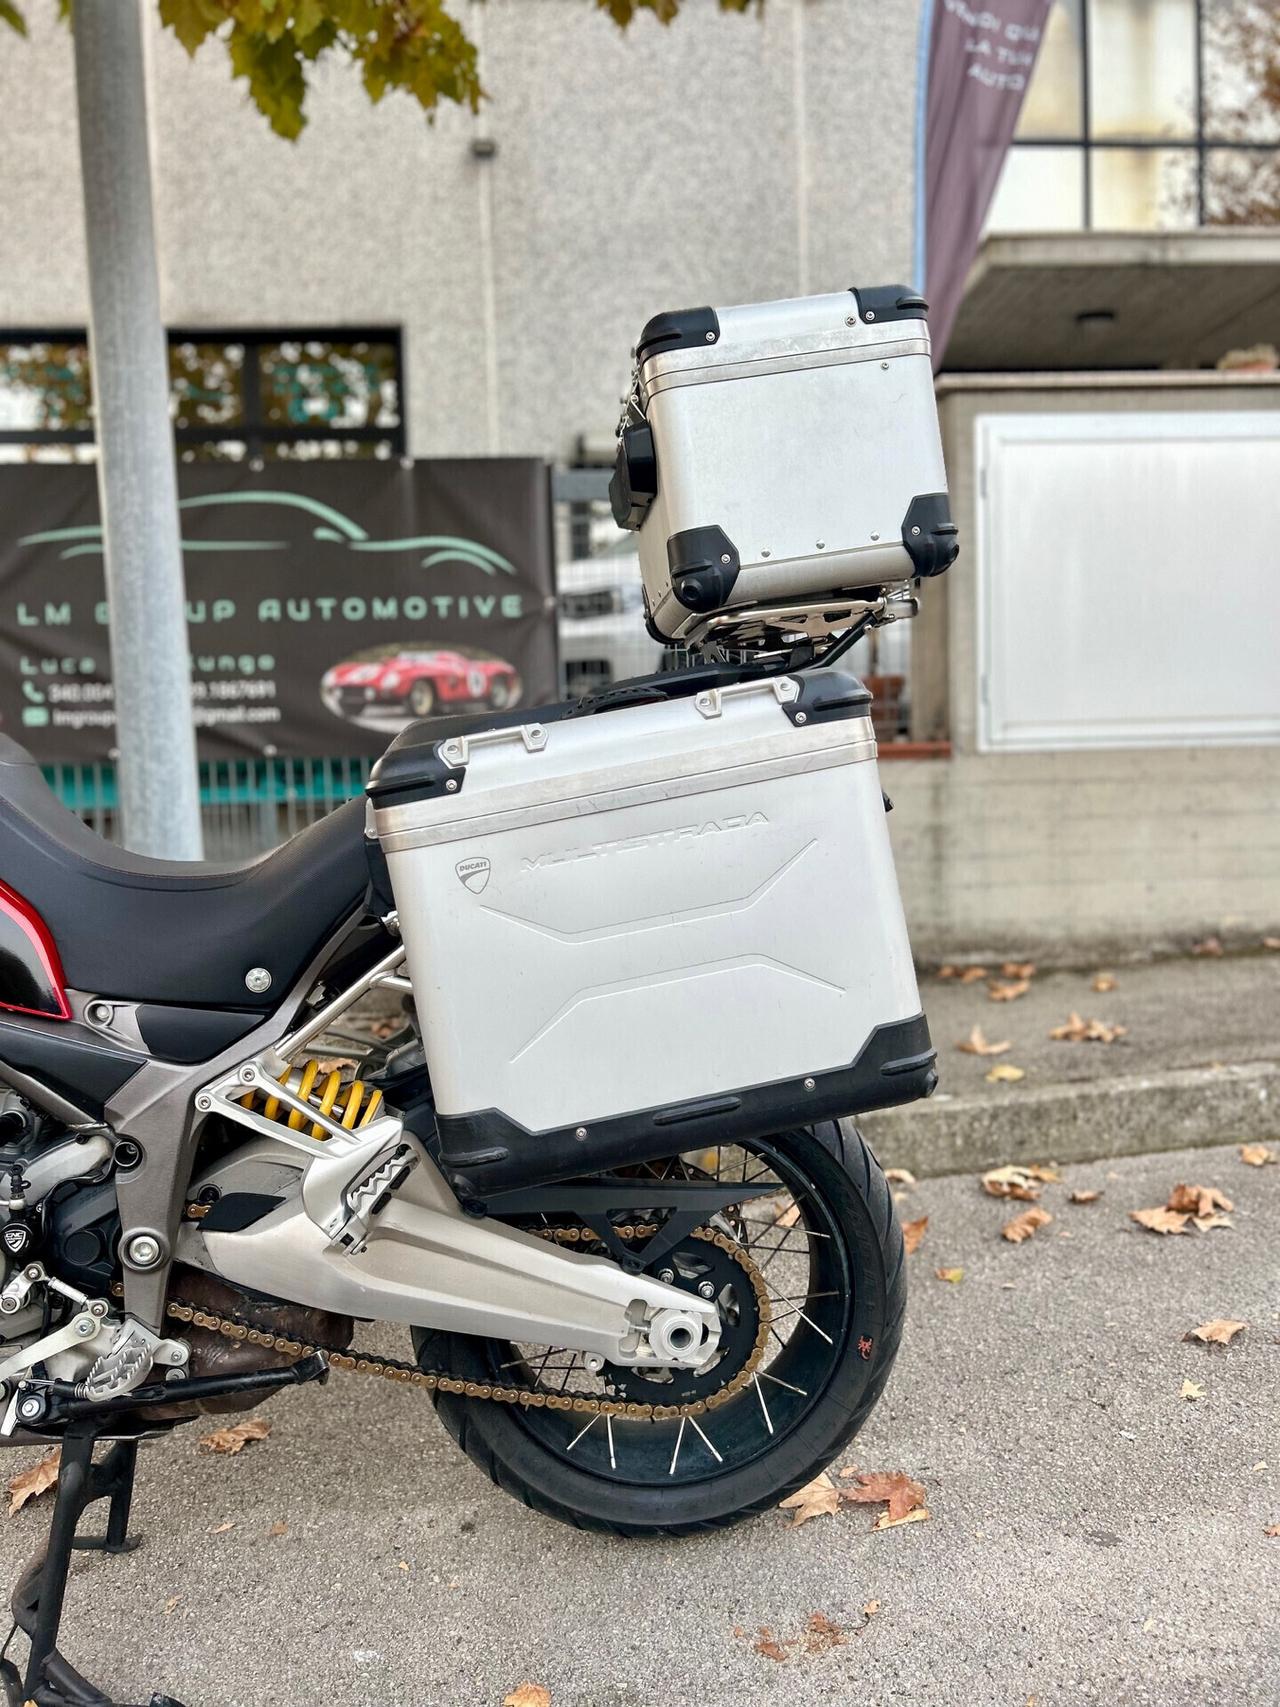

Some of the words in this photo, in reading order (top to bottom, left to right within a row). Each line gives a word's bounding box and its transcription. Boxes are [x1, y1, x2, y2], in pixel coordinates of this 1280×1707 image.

[968, 63, 1024, 89] AUTO
[17, 602, 71, 626] LM
[258, 595, 522, 622] AUTOMOTIVE
[520, 811, 769, 872] MULTISTRADA
[459, 861, 487, 871] DUCATI
